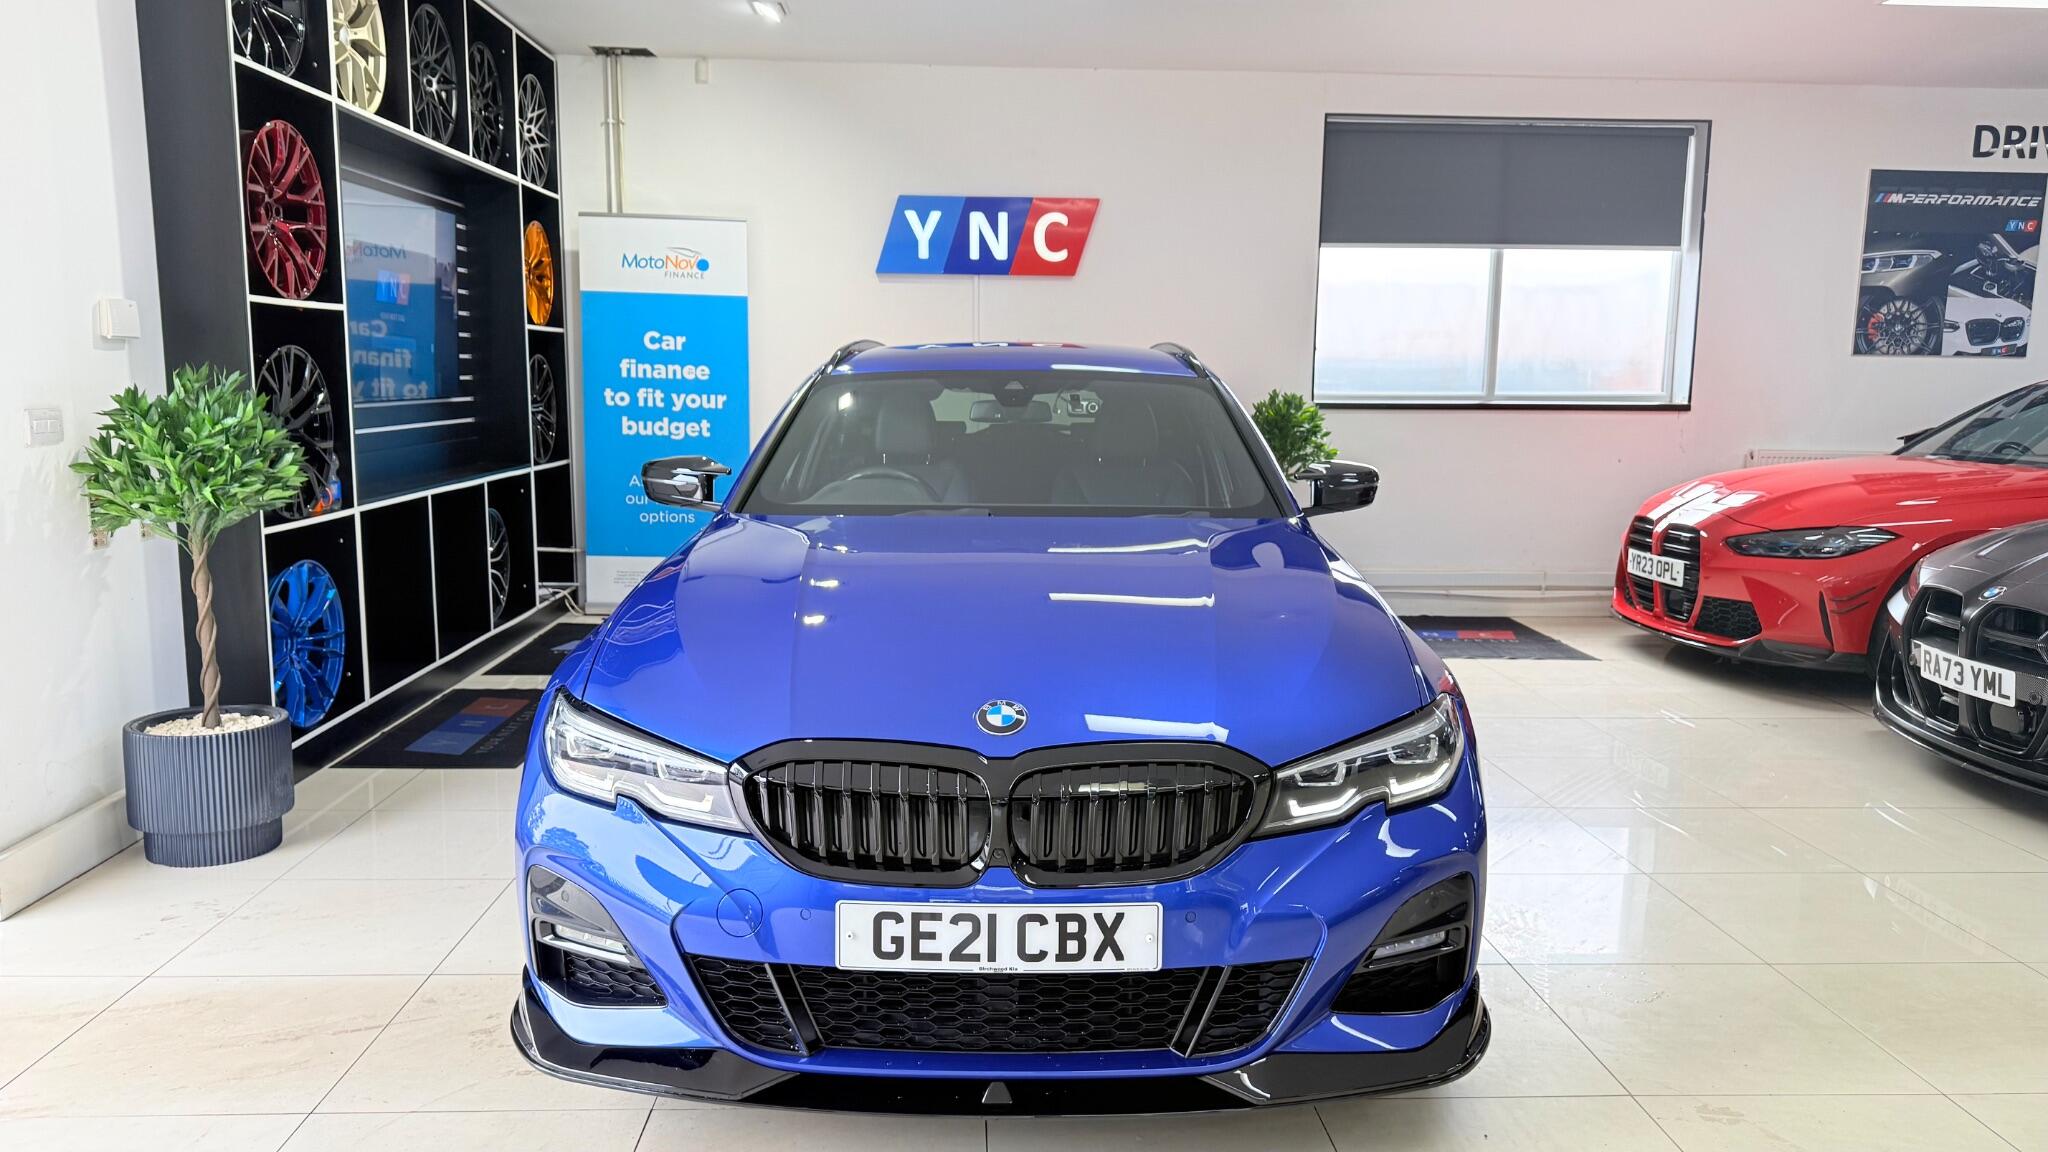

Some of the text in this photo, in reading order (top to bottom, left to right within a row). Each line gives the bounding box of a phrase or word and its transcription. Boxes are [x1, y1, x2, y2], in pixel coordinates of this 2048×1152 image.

[1972, 124, 2048, 159] DRI
[904, 209, 1069, 263] YNC
[2010, 220, 2034, 231] YNC
[621, 252, 710, 272] MotoNovo
[664, 271, 705, 280] FINANCE
[643, 331, 687, 351] Car
[619, 358, 711, 380] finance
[603, 387, 728, 412] to fit your
[621, 416, 711, 440] budget
[640, 511, 695, 525] options
[1631, 551, 1654, 576] YR23
[1923, 648, 2011, 701] RA73 YML
[872, 911, 1125, 963] GE21 CBX
